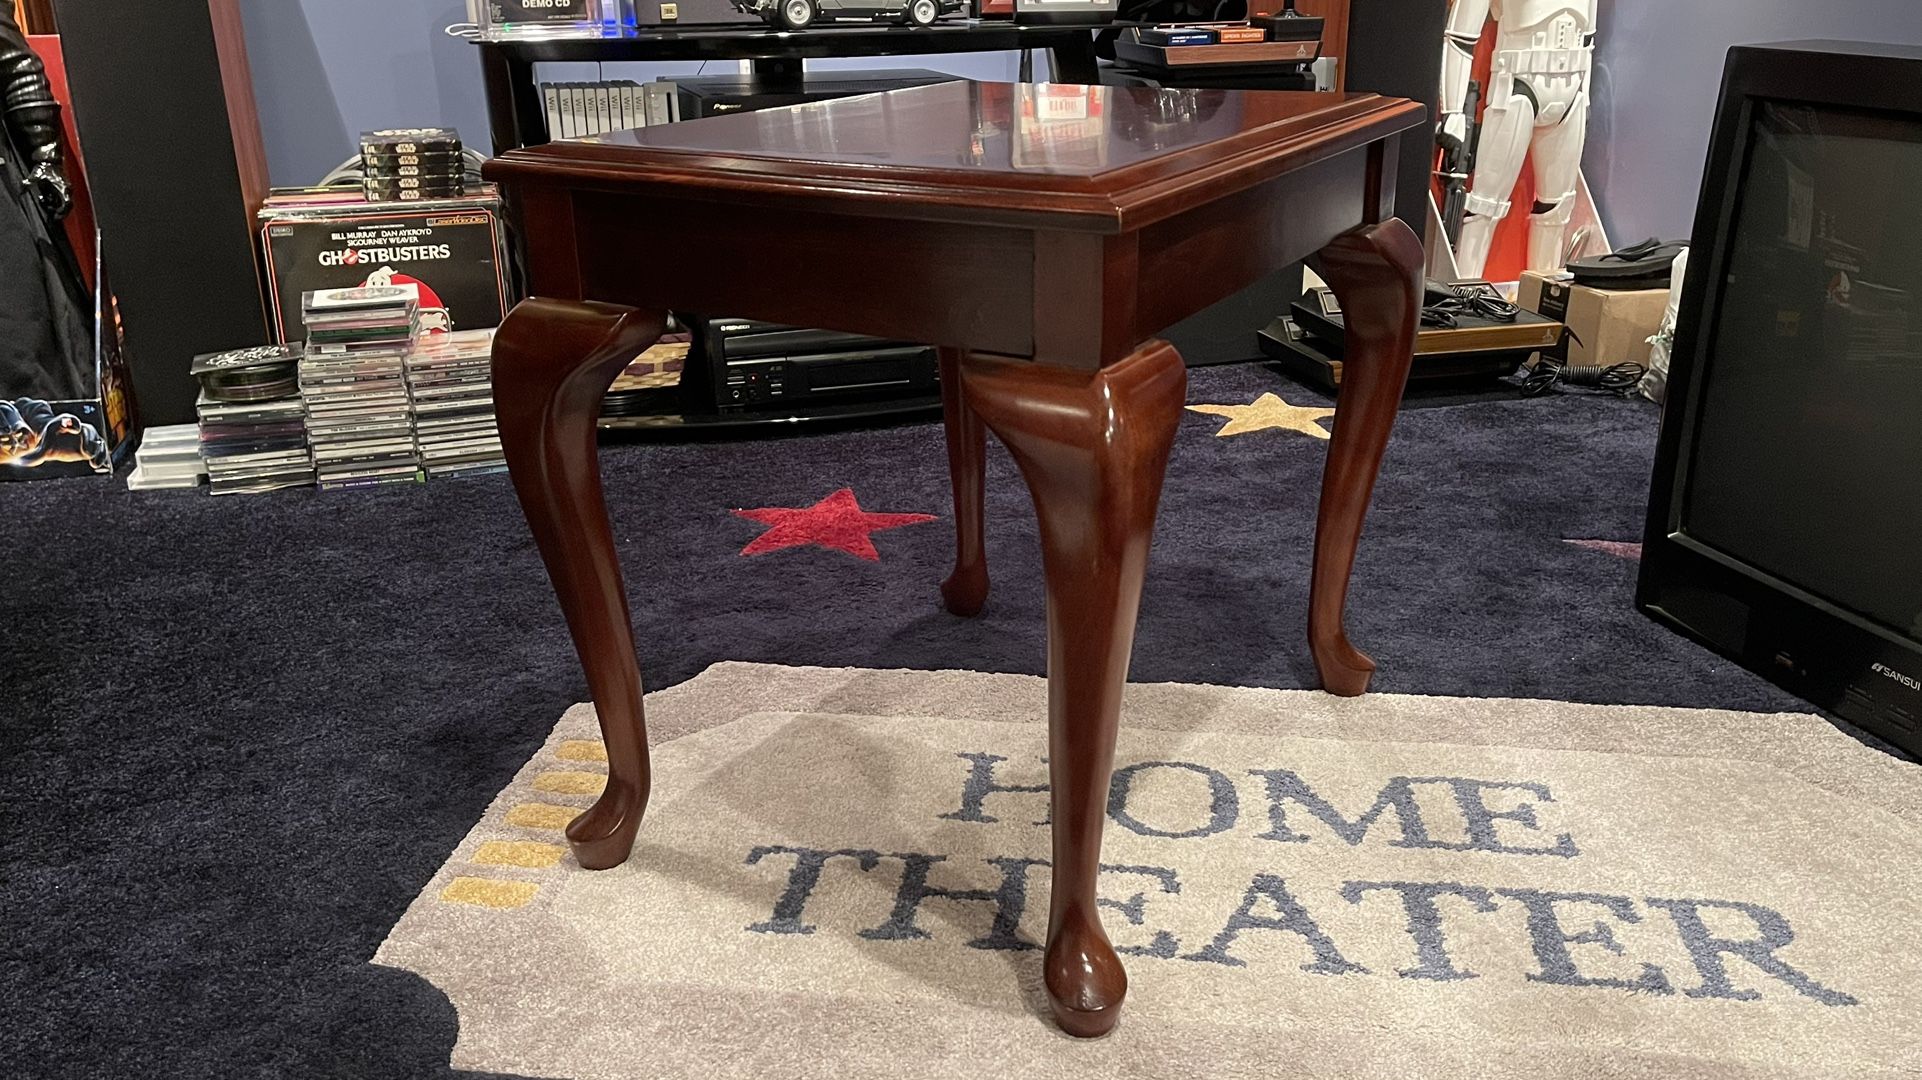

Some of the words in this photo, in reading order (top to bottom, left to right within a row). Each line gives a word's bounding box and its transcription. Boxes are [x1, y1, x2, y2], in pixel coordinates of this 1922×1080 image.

[521, 0, 552, 8] DEMO
[555, 0, 571, 8] CD
[346, 231, 377, 239] MURRAY
[381, 229, 398, 237] DAN
[398, 228, 432, 236] AYKROYD
[347, 238, 387, 247] SIGOURNEY
[388, 236, 419, 244] WEAVER
[318, 244, 451, 266] GHOSTBUSTERS
[1883, 667, 1921, 691] SANSUI
[937, 752, 1581, 859] HOME
[744, 845, 1858, 1006] THEATER
